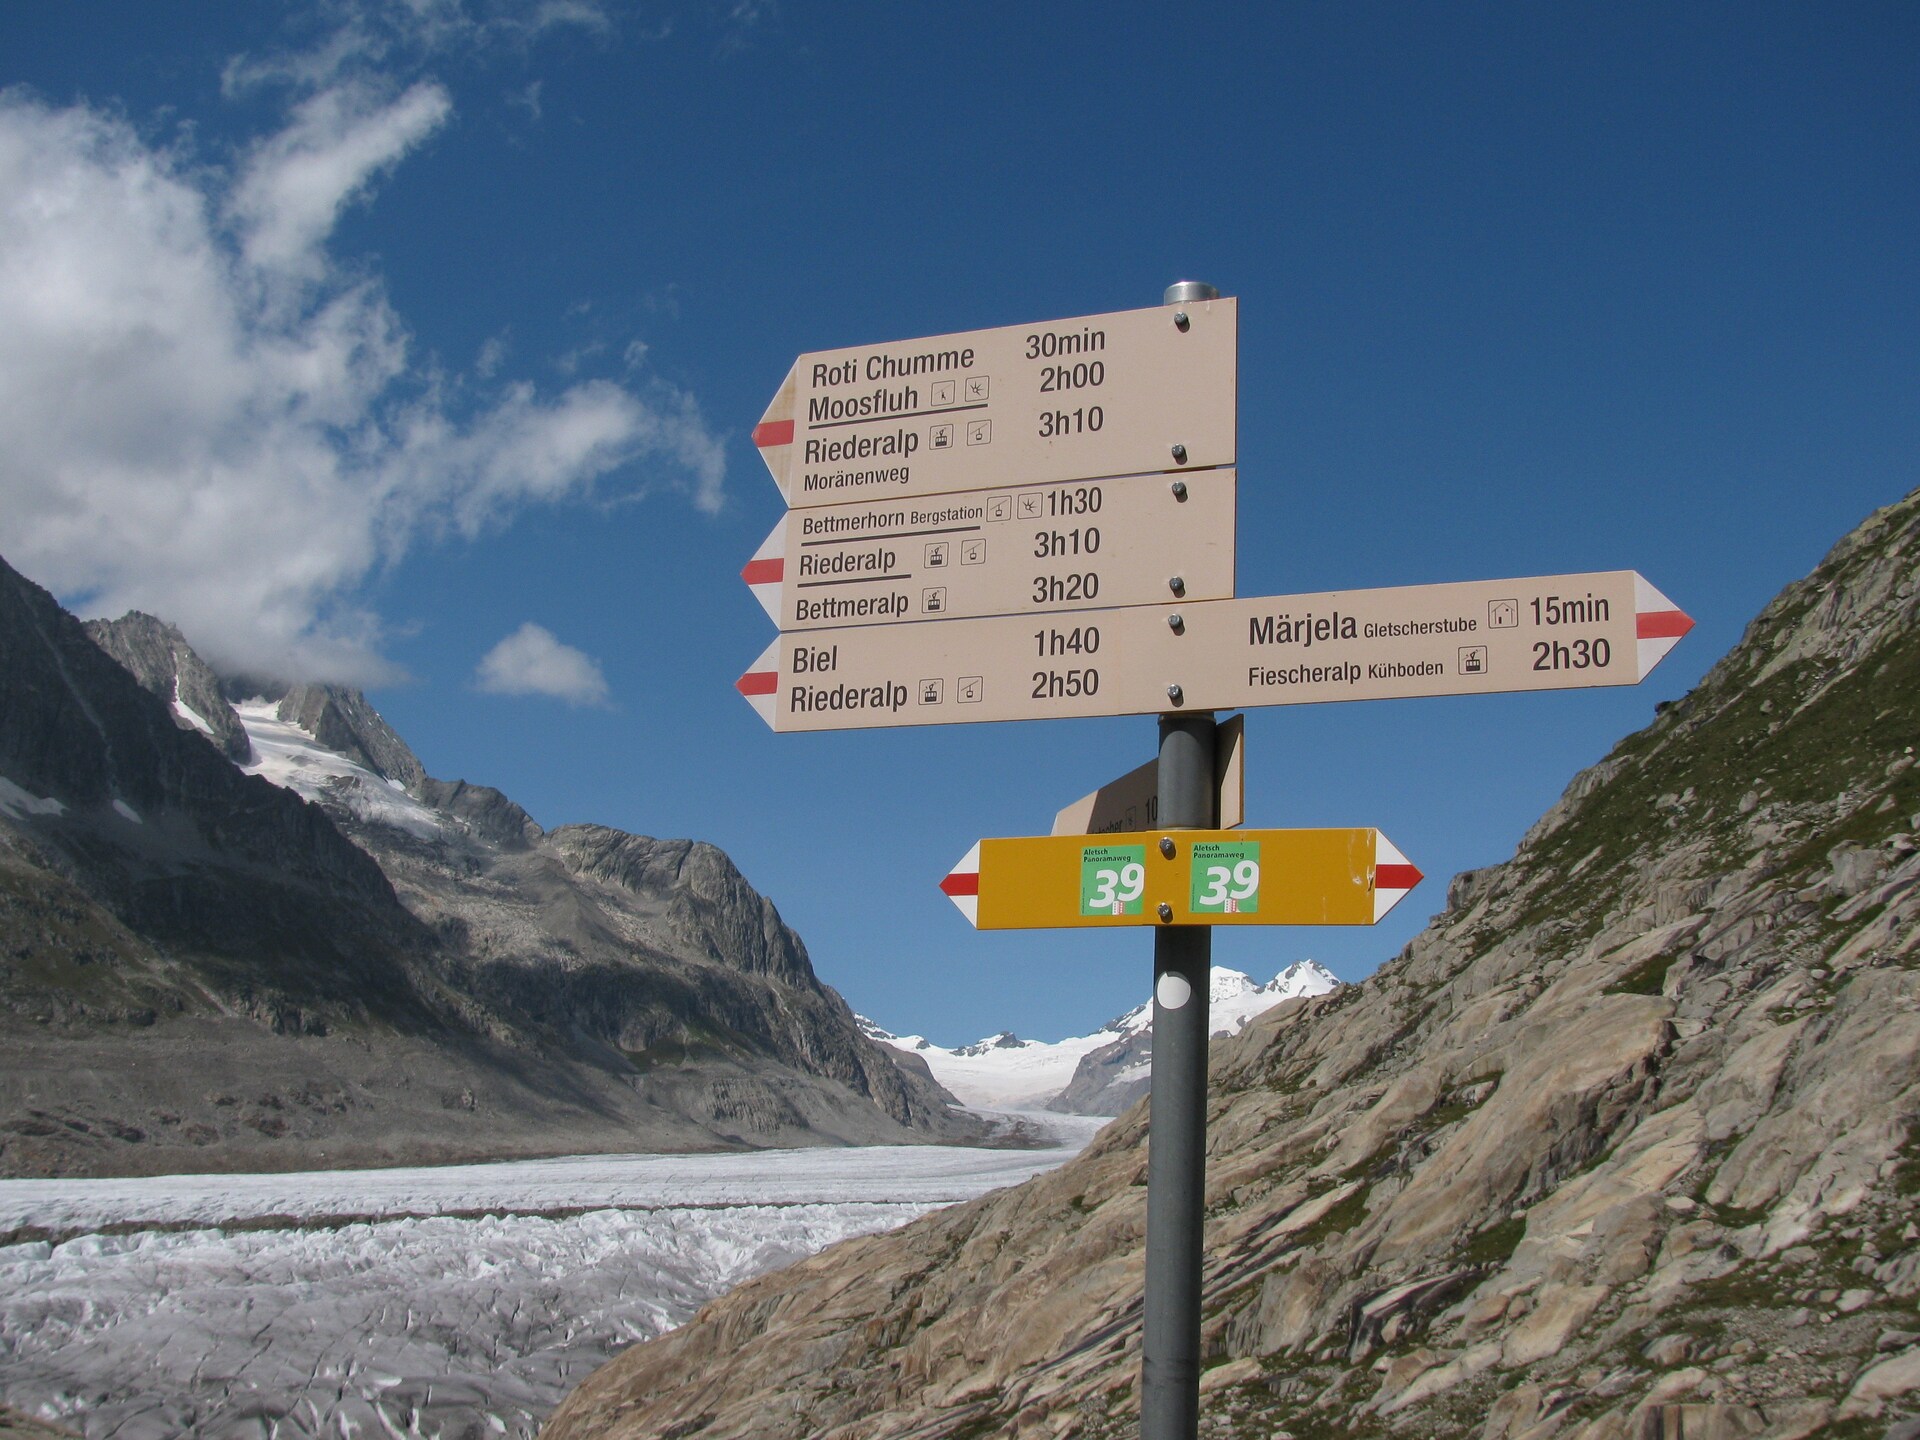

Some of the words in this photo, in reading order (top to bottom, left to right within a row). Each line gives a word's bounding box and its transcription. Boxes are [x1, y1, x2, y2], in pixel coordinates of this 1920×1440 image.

[1025, 327, 1105, 360] 30min
[812, 358, 858, 388] Roti
[866, 348, 974, 381] Chumme
[1040, 361, 1105, 393] 2h00
[808, 386, 919, 422] Moosfluh
[1038, 406, 1104, 438] 3h10
[805, 428, 919, 464] Riederalp
[804, 467, 909, 492] Moränenweg
[1047, 486, 1102, 516] 1h30
[803, 511, 905, 535] Bettmerhorn
[909, 506, 983, 526] Bergstation
[1034, 527, 1100, 558] 3h10
[799, 548, 896, 576] Riederalp
[1032, 572, 1099, 603] 3h20
[796, 592, 909, 621] Bettmeralp
[1530, 593, 1609, 626] 15min
[1034, 626, 1100, 657] 1h40
[1249, 611, 1358, 648] Märjela
[1364, 617, 1477, 638] Gletscherstube
[792, 645, 838, 674] Biel
[1532, 638, 1611, 671] 2h30
[1031, 668, 1099, 699] 2h50
[1249, 661, 1361, 687] Fiescheralp
[1368, 661, 1443, 679] Kühboden
[791, 680, 908, 713] Riederalp
[1083, 848, 1109, 856] Aletsch
[1193, 844, 1220, 852] Aletsch
[1193, 852, 1245, 860] Panoramaweg
[1089, 863, 1145, 908] 39
[1199, 860, 1259, 906] 39
